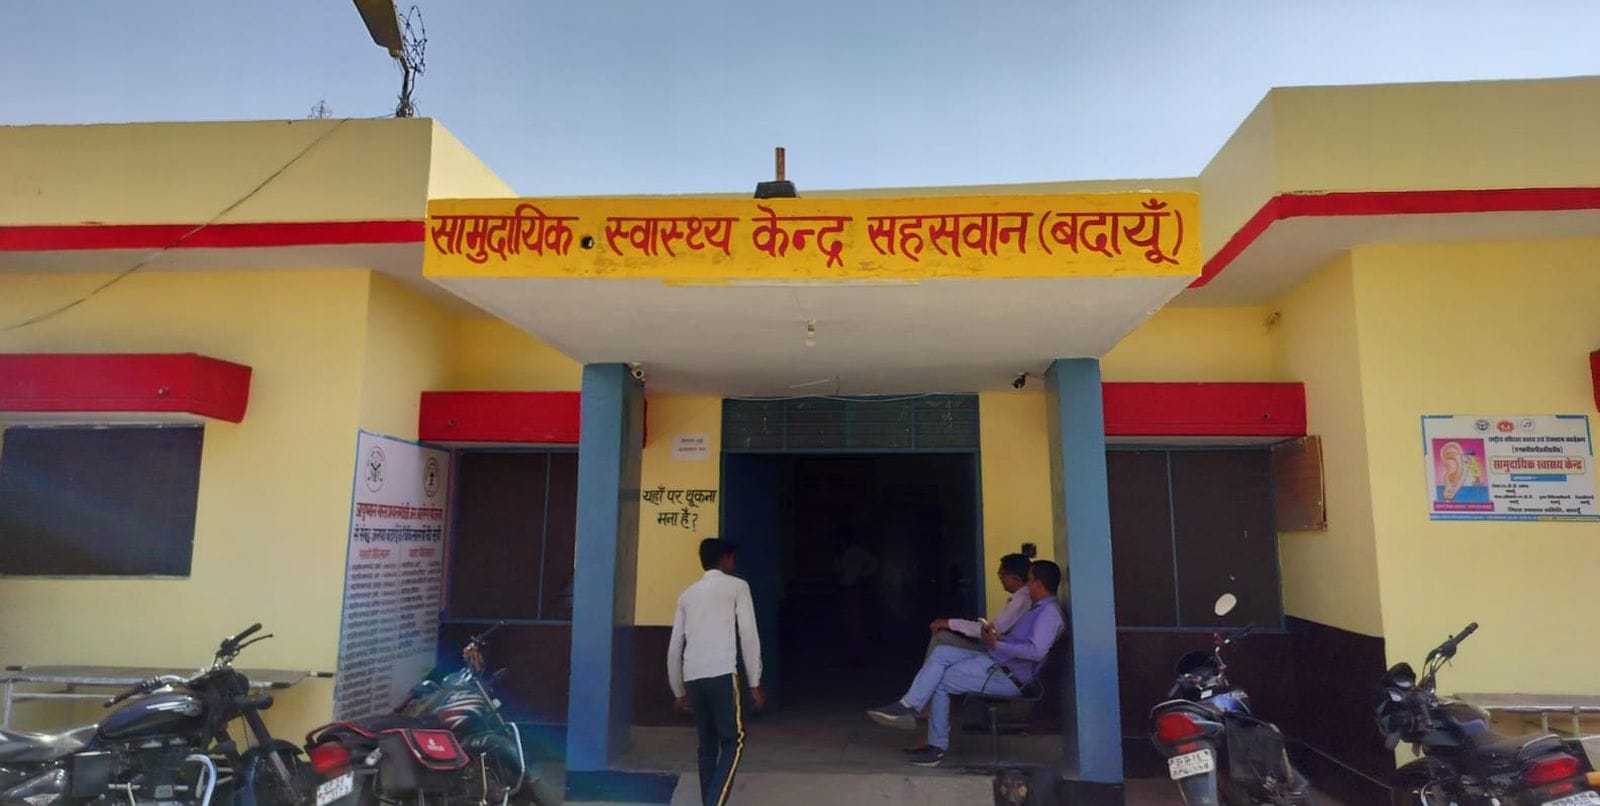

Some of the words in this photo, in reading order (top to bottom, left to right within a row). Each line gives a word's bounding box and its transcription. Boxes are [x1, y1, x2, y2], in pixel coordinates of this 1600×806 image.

[431, 203, 580, 264] सामुदायिक
[605, 216, 740, 257] स्वास्थ्य
[751, 204, 853, 268] केन्द्र
[867, 212, 1034, 262] सहसवान
[1038, 198, 1184, 265] (बदायूँ)
[1493, 457, 1535, 473] सामुदायिक
[1565, 457, 1583, 470] केन्द्र
[642, 484, 666, 506] यहाँ
[667, 489, 685, 504] पर
[685, 489, 718, 508] थूकना
[657, 512, 679, 526] मना
